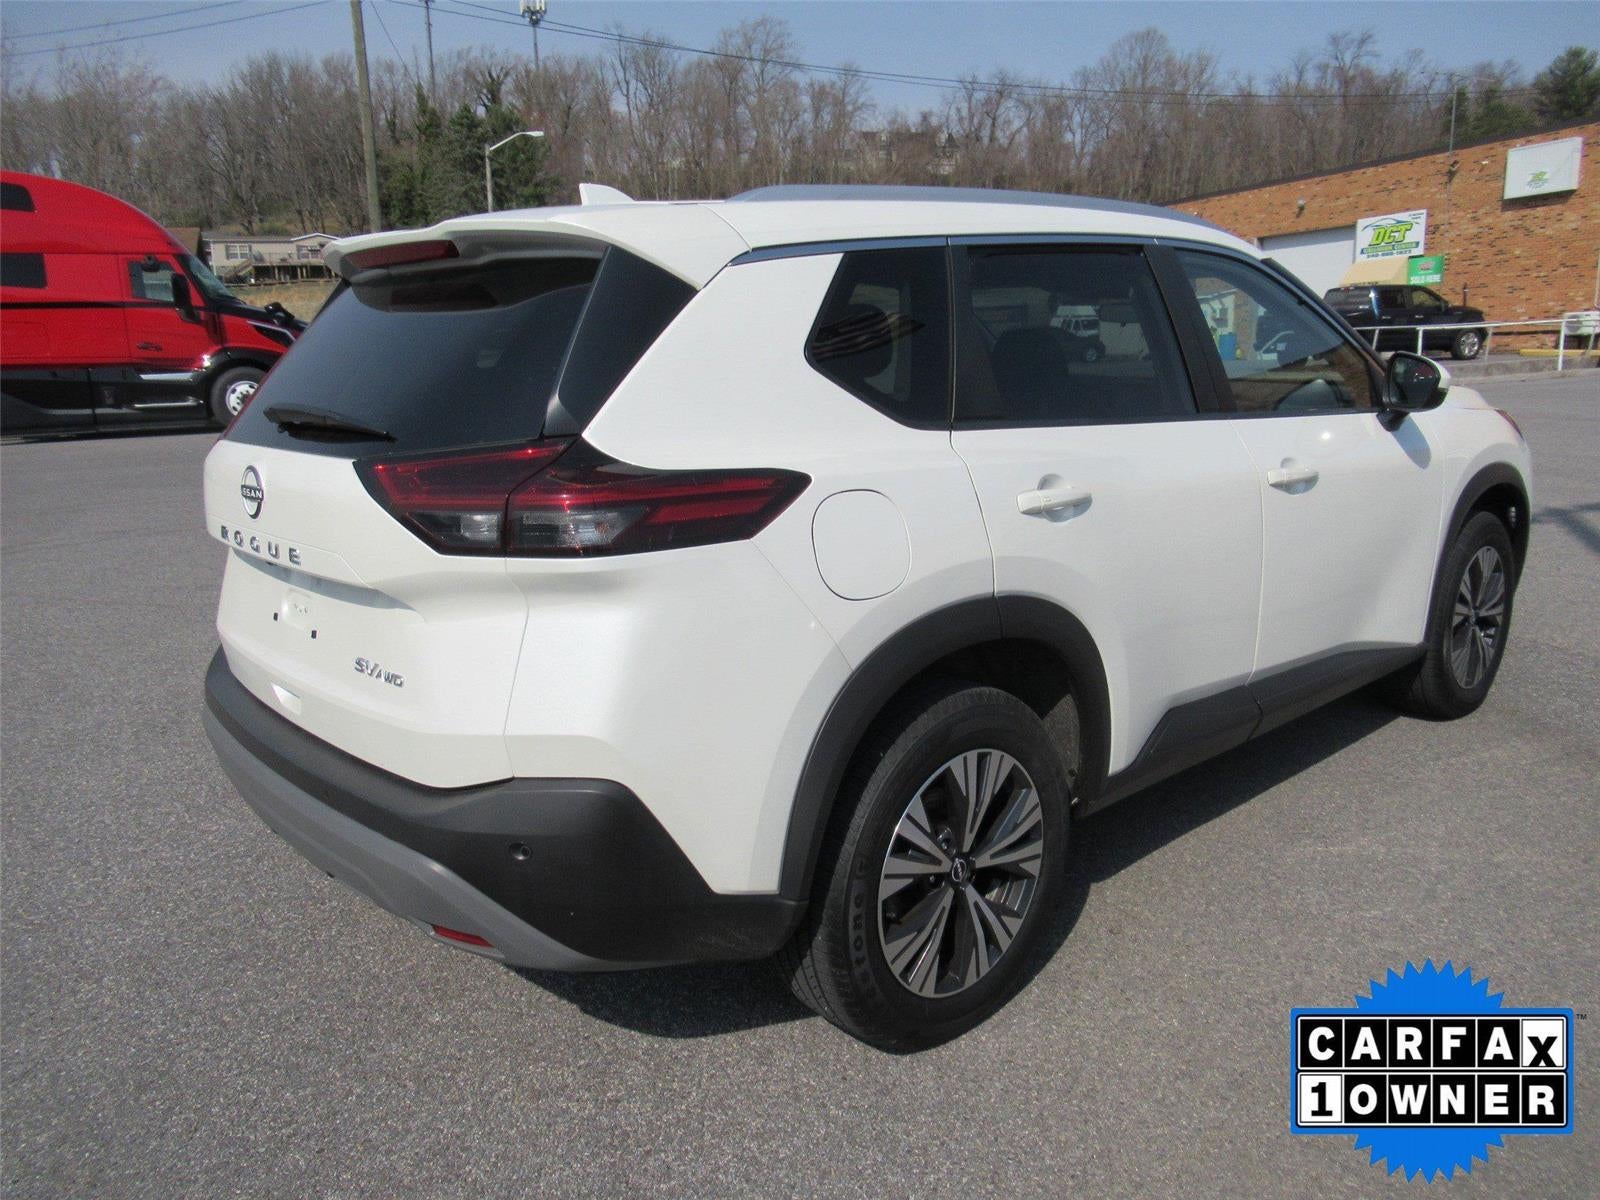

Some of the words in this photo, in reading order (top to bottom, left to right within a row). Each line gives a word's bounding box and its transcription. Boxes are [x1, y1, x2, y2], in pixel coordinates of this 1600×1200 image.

[1369, 223, 1413, 246] DCT
[241, 487, 262, 498] SSAN
[221, 525, 301, 565] ROGUE
